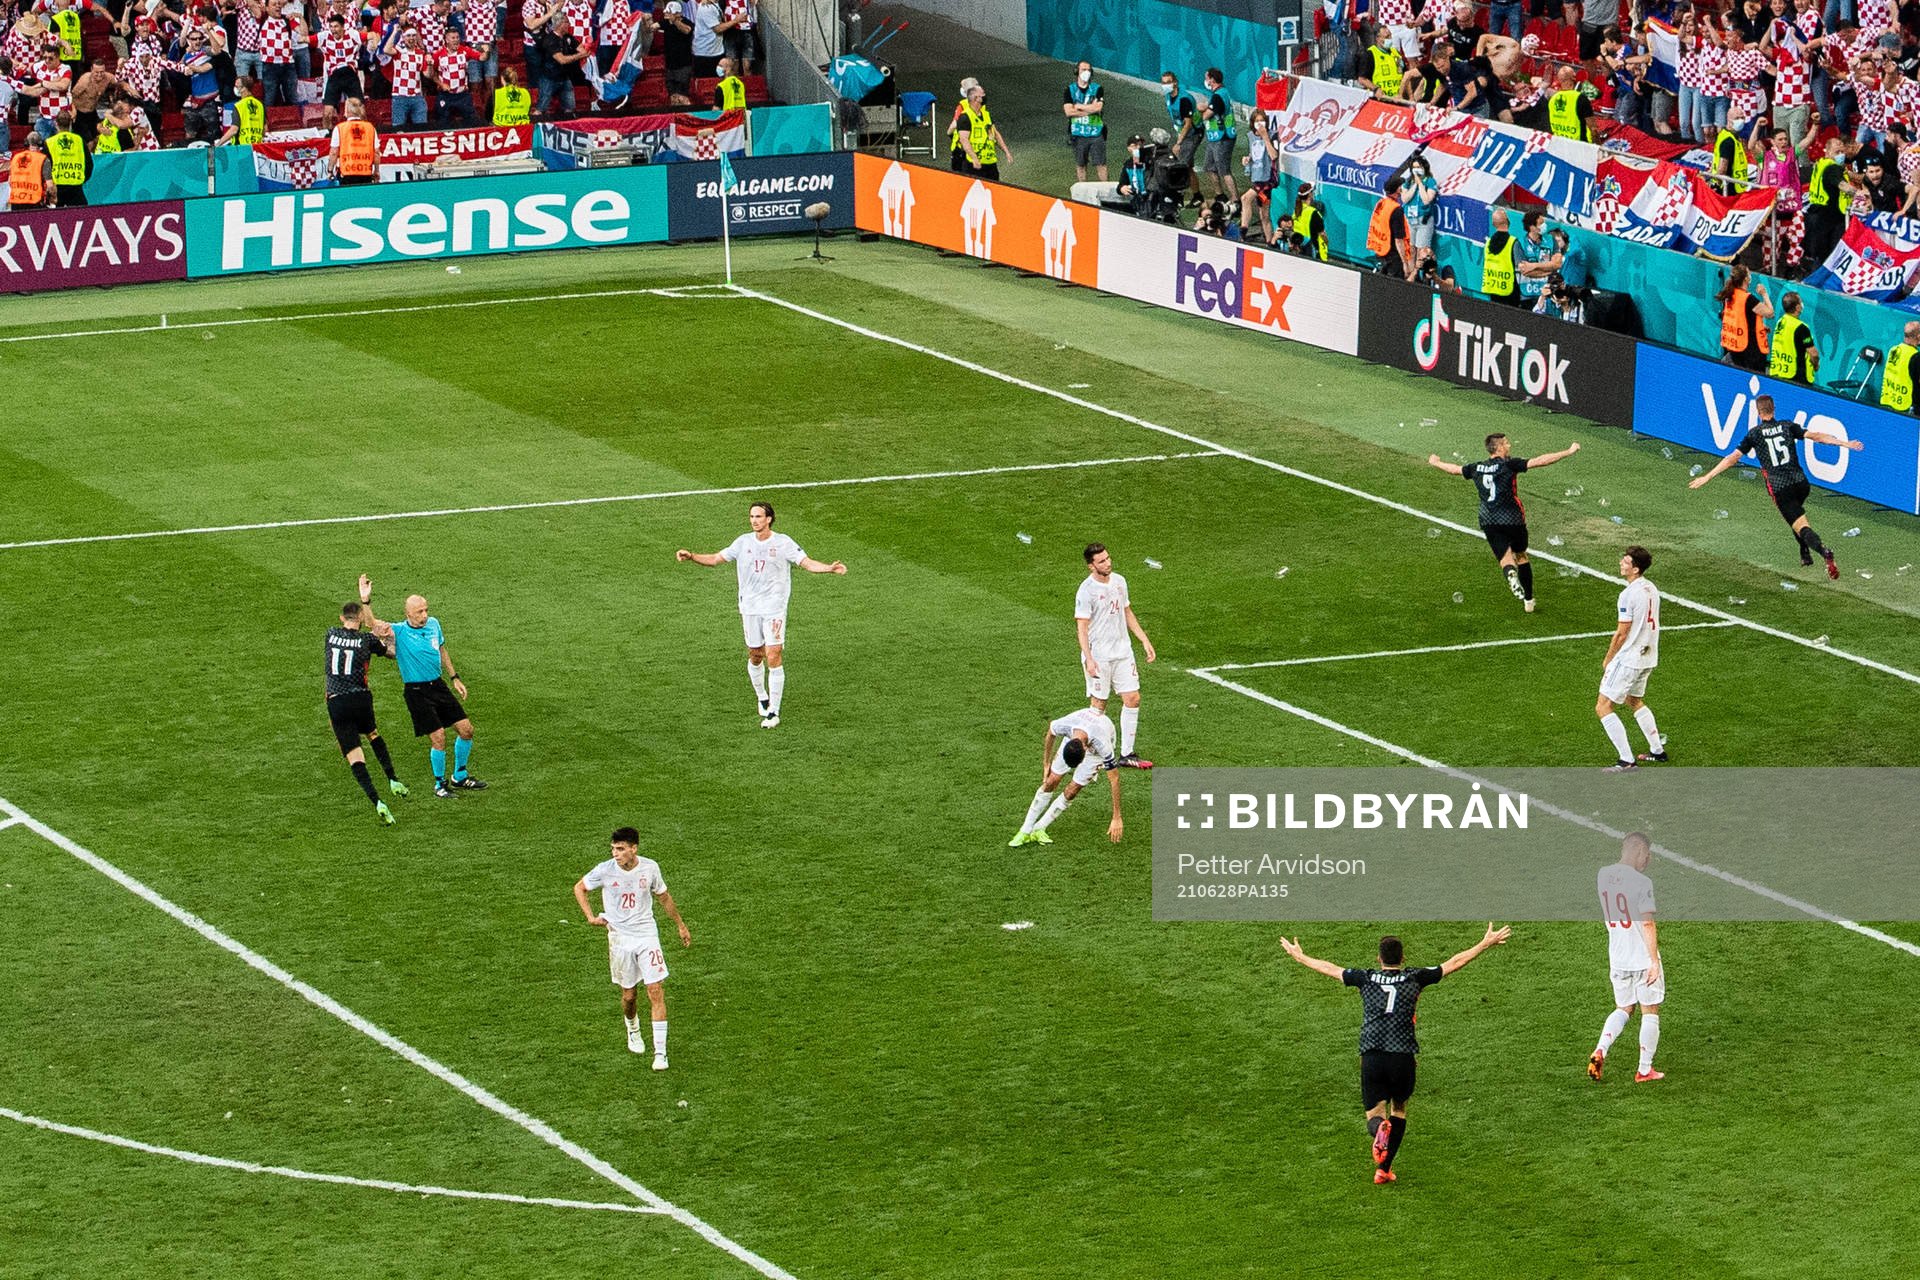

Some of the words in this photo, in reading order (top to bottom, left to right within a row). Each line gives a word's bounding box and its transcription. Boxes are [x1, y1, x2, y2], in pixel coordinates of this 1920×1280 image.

[375, 128, 521, 158] AMEŠNICA
[749, 203, 801, 218] RESPECT
[222, 190, 629, 271] Hisense
[1175, 233, 1293, 332] FedEx
[1454, 318, 1571, 404] TikTok
[1701, 375, 1849, 483] vio
[1764, 435, 1790, 467] 15
[1482, 473, 1497, 502] 9
[754, 559, 766, 573] 17
[1109, 599, 1120, 615] 24
[1647, 598, 1656, 631] 4
[331, 647, 354, 675] 11
[621, 892, 636, 909] 26
[1602, 890, 1632, 929] 19
[648, 949, 664, 967] 26
[1380, 984, 1397, 1013] 7
